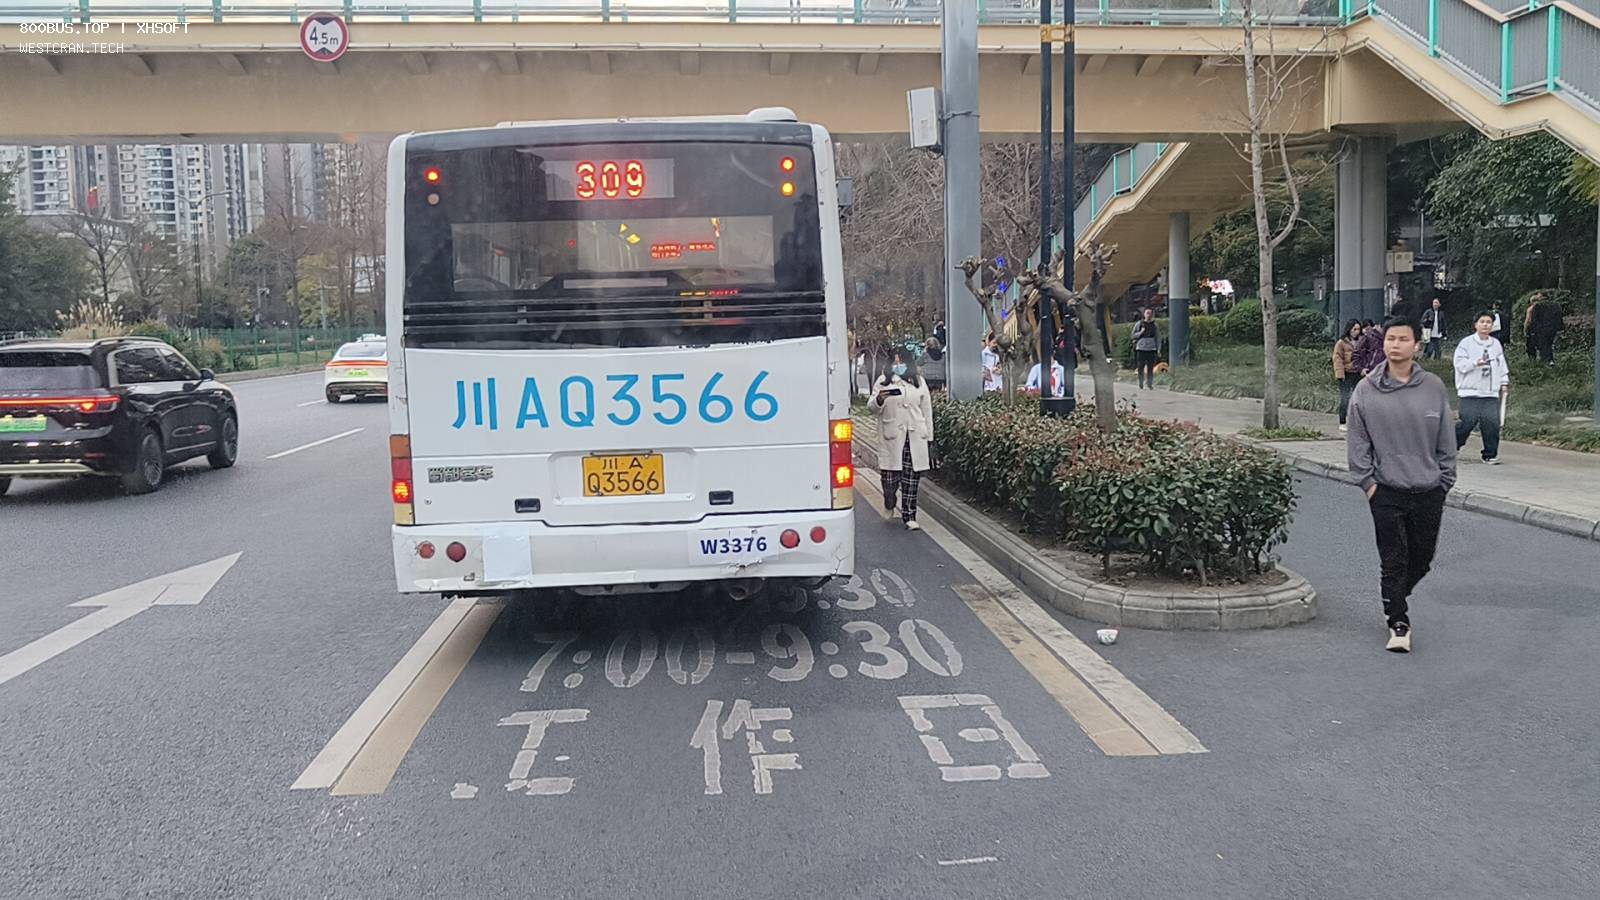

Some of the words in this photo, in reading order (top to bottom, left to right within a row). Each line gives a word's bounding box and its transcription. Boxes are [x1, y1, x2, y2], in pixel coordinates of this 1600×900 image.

[309, 26, 339, 45] 4.5m
[576, 160, 643, 199] 309
[451, 370, 779, 431] 川AQ3566
[587, 471, 659, 493] Q3566
[700, 536, 767, 555] W3376
[497, 694, 1051, 796] 工作日
